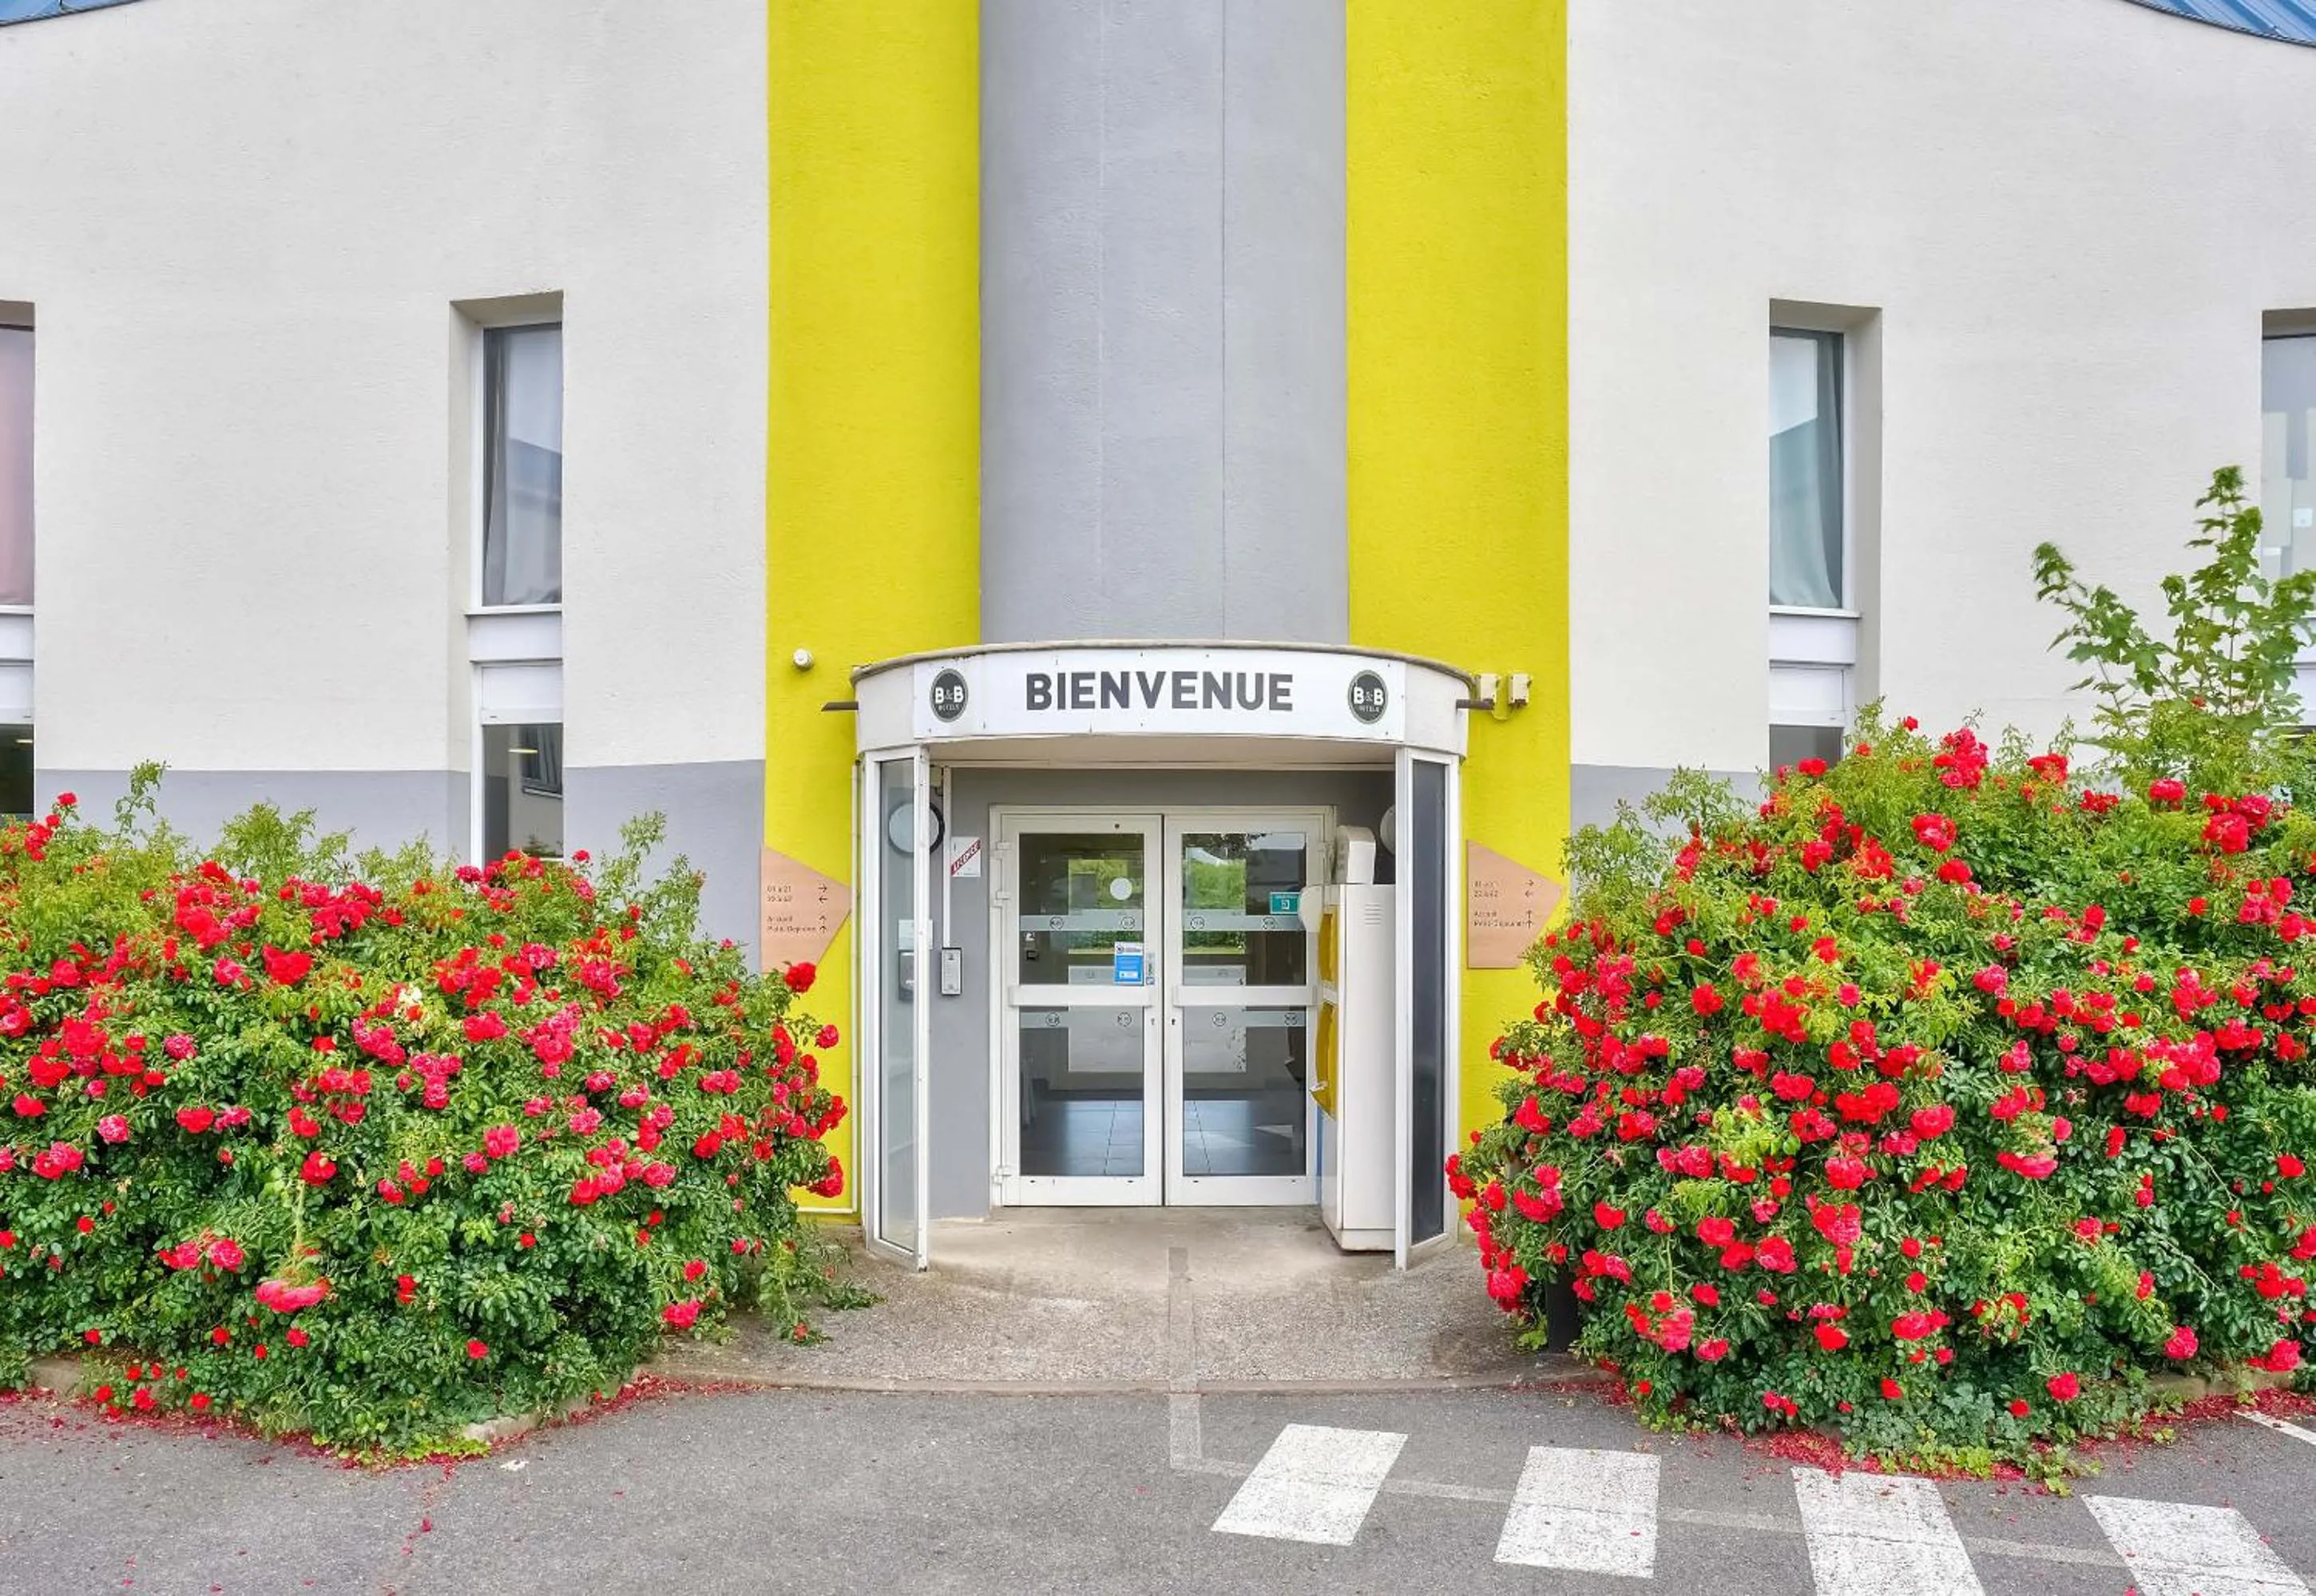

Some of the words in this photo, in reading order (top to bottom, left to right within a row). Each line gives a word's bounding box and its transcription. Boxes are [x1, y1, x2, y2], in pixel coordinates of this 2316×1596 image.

[935, 685, 964, 703] B&B
[1026, 671, 1293, 711] BIENVENUE
[1354, 686, 1384, 706] B&B
